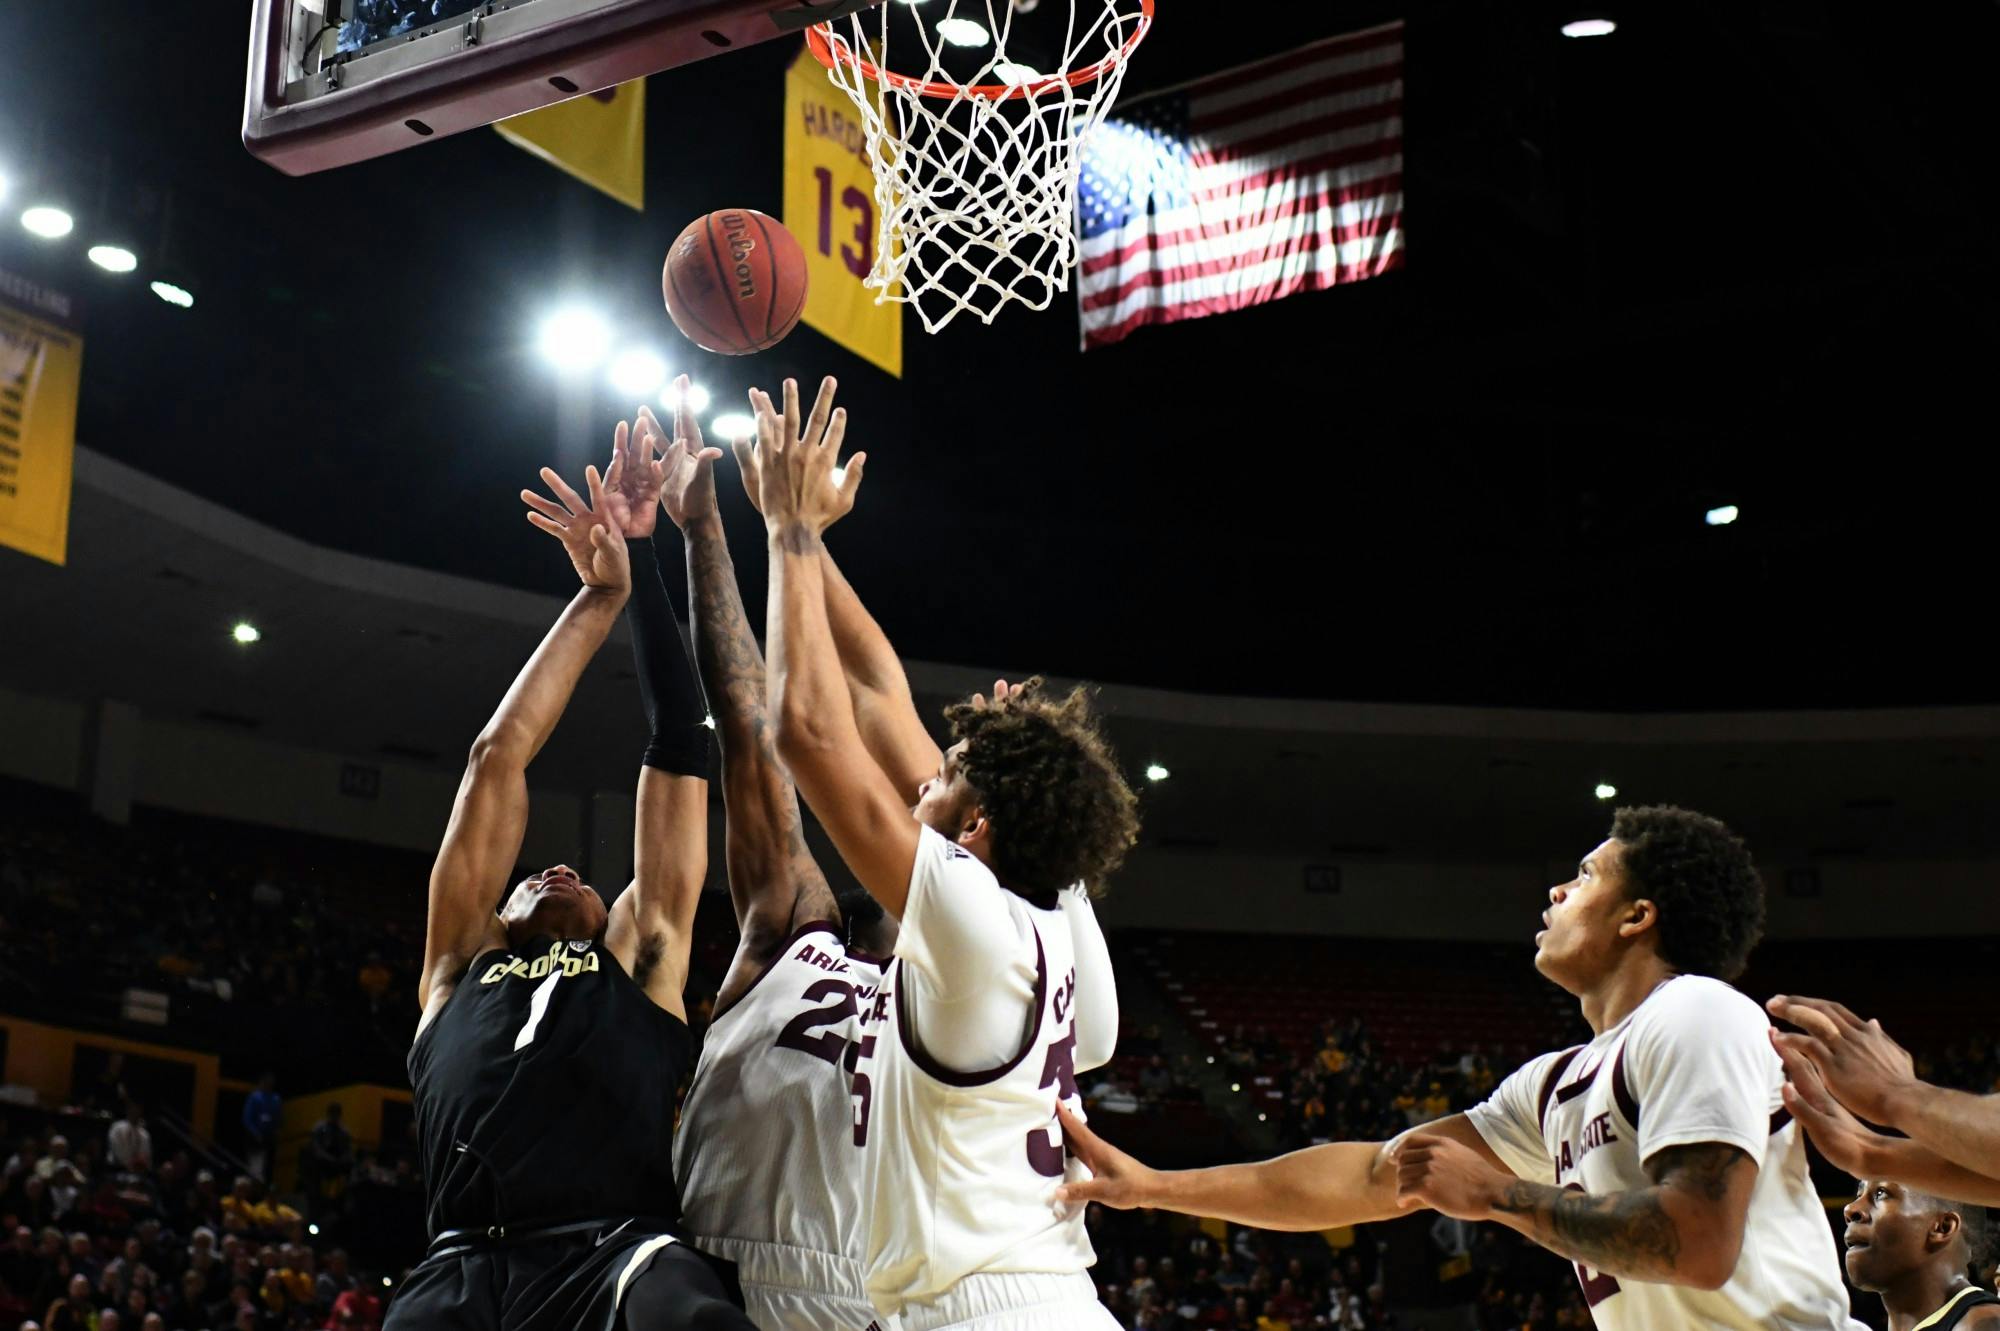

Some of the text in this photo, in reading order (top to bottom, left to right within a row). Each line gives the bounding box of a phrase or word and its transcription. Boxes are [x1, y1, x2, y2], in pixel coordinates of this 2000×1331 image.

[802, 101, 880, 169] HARDE
[721, 213, 757, 299] Wilson
[814, 166, 874, 280] 13
[514, 969, 563, 1052] 1
